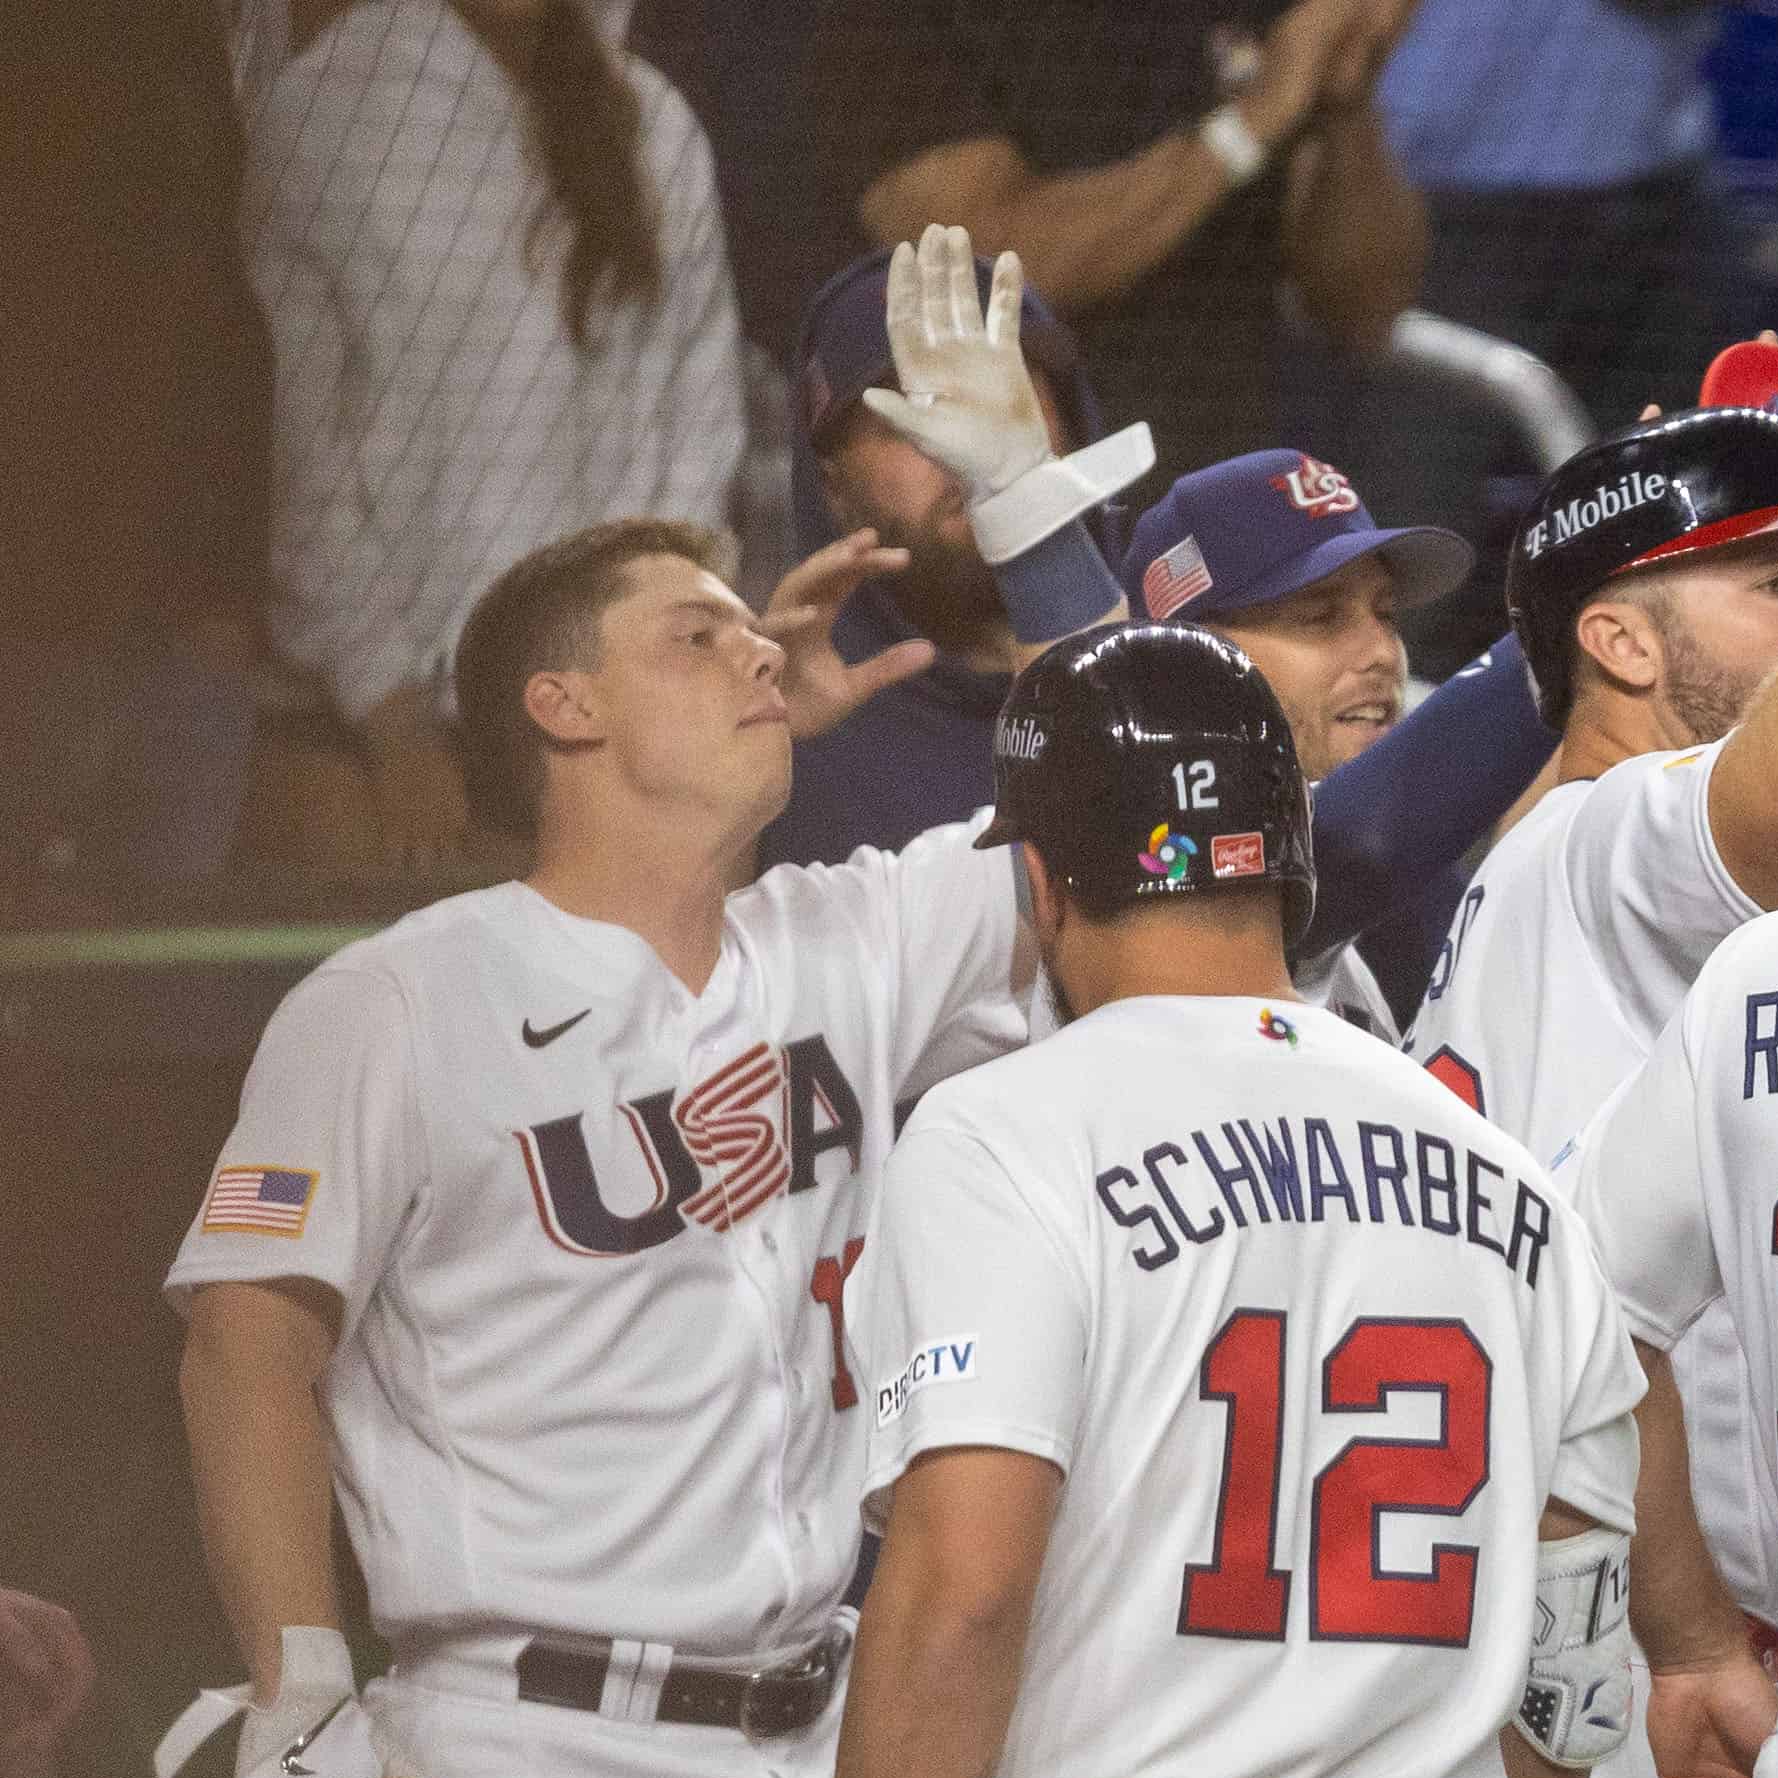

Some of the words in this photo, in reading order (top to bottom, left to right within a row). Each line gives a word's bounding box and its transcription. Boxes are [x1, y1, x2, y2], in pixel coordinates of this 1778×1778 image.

[1000, 716, 1046, 761] obile
[1171, 759, 1219, 811] 12
[512, 1033, 863, 1259] USA
[1095, 1117, 1552, 1290] SCHWARBER
[1175, 1307, 1494, 1649] 12
